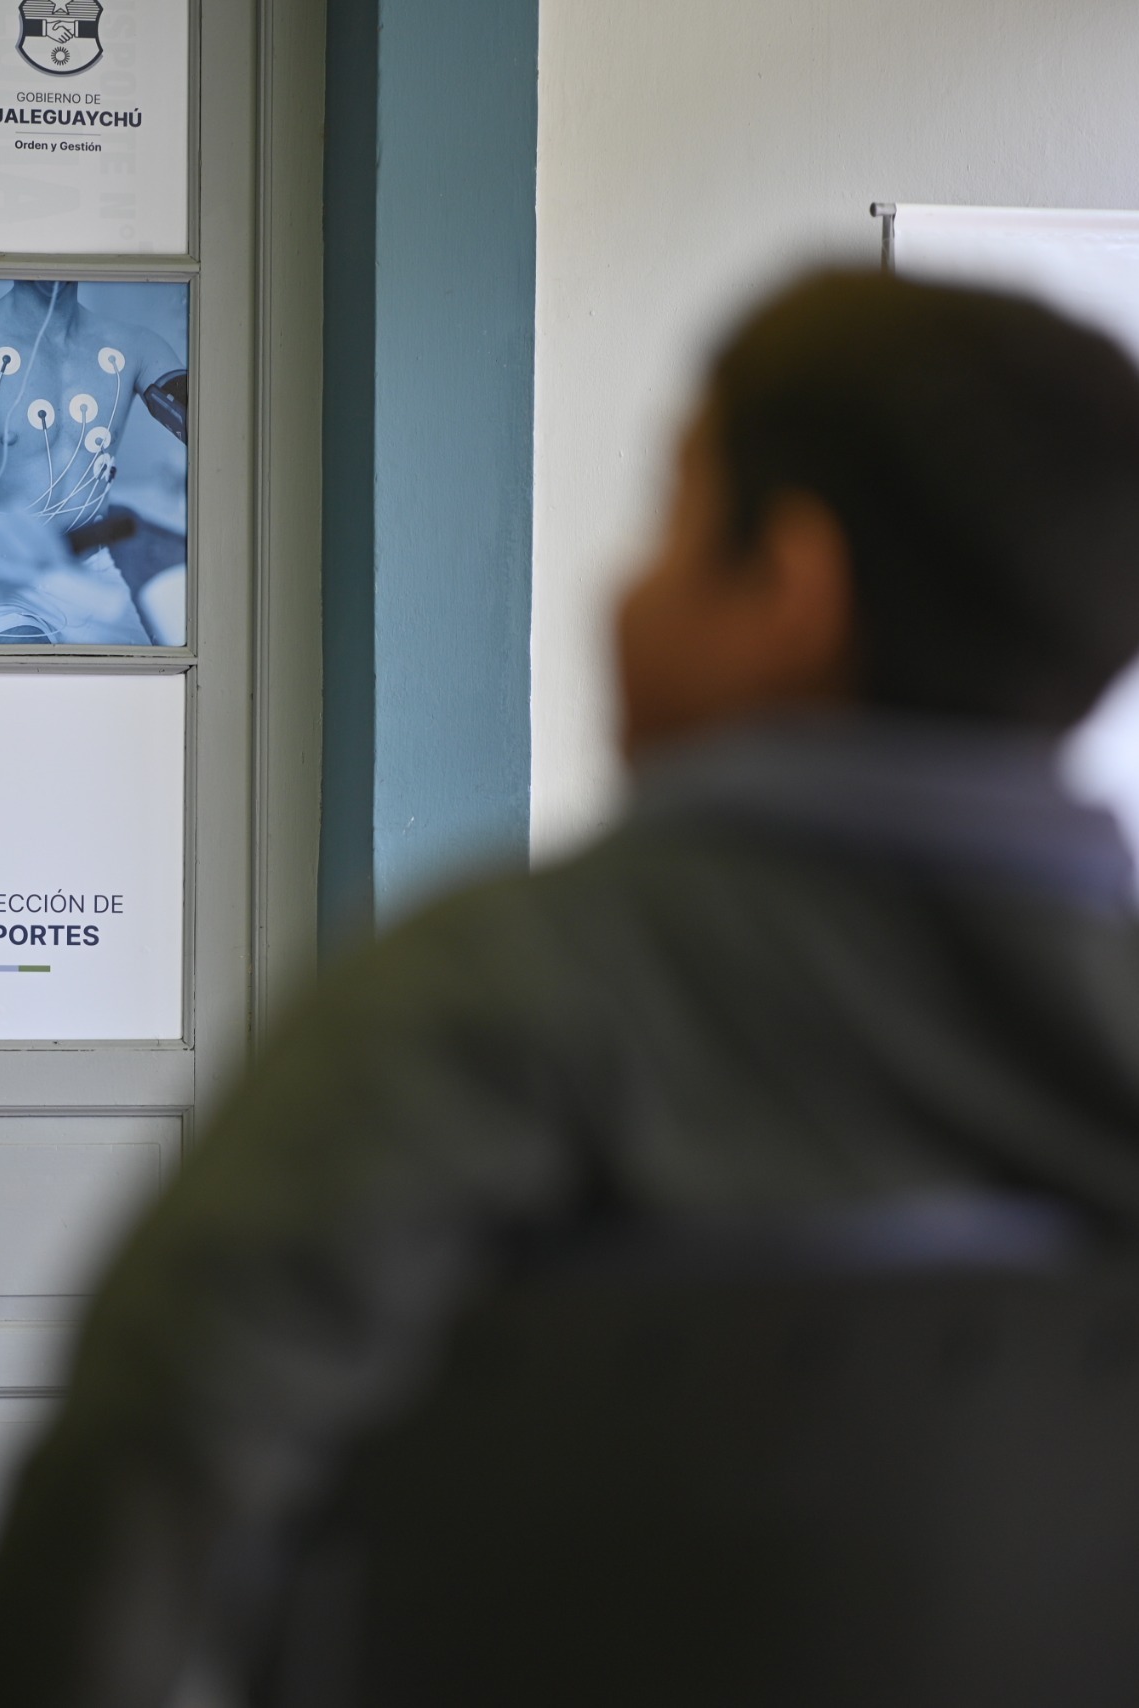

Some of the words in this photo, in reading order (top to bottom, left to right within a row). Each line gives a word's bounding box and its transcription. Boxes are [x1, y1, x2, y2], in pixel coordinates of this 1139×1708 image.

[16, 92, 81, 104] GOBIERNO
[85, 93, 101, 105] DE
[15, 140, 48, 151] Orden
[51, 143, 57, 152] y
[59, 140, 101, 152] Gestión
[94, 895, 123, 913] DE
